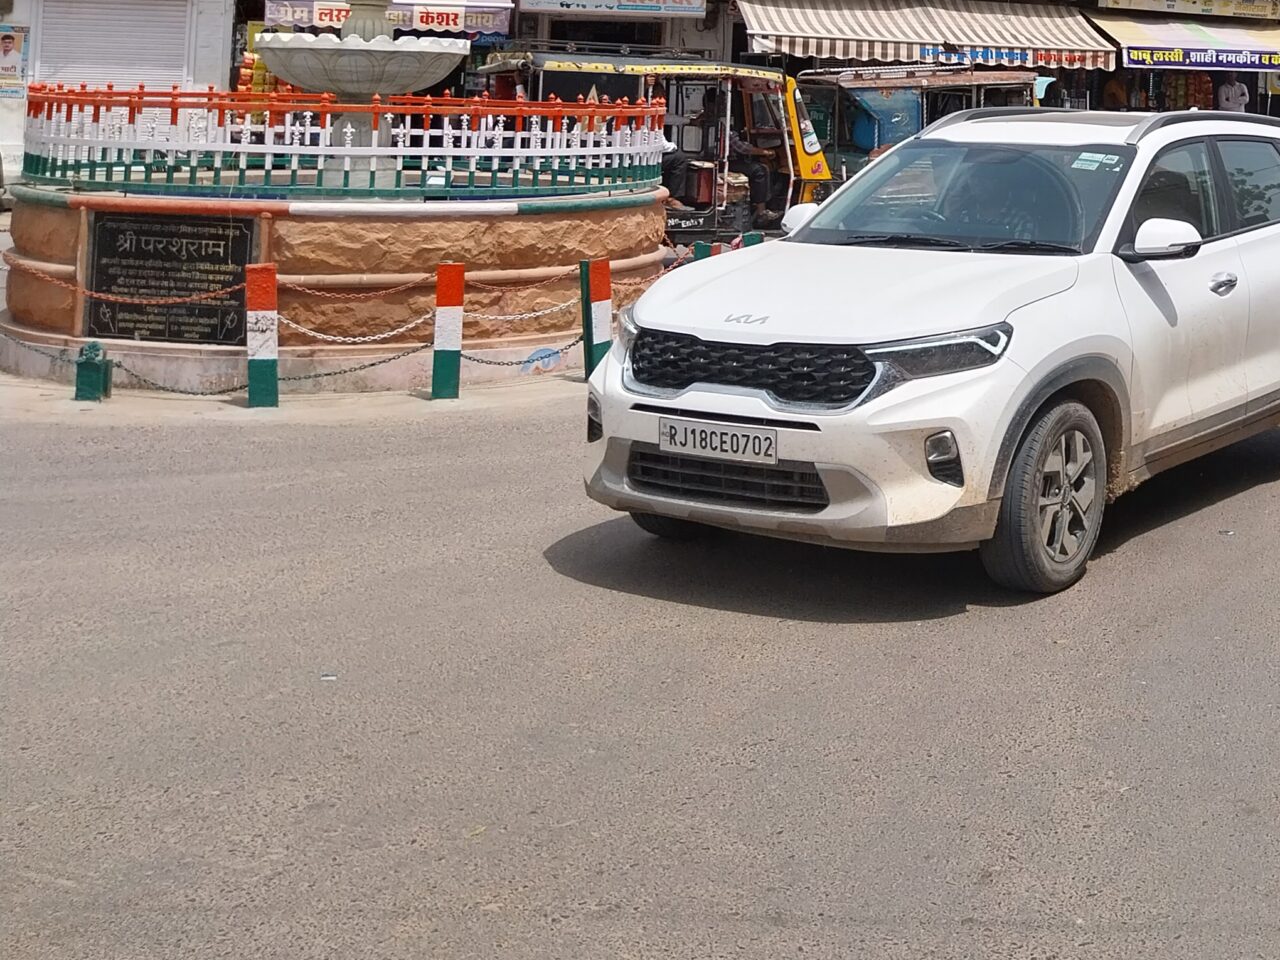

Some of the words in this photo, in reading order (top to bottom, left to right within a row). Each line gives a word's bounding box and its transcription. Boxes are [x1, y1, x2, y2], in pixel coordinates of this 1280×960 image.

[1129, 48, 1153, 65] बाबू
[1153, 48, 1183, 62] लस्सी
[1218, 50, 1260, 65] नमकीन
[1261, 54, 1270, 64] व
[116, 231, 137, 253] श्री
[139, 236, 226, 260] परशुराम
[668, 424, 773, 458] RJ18CE0702
